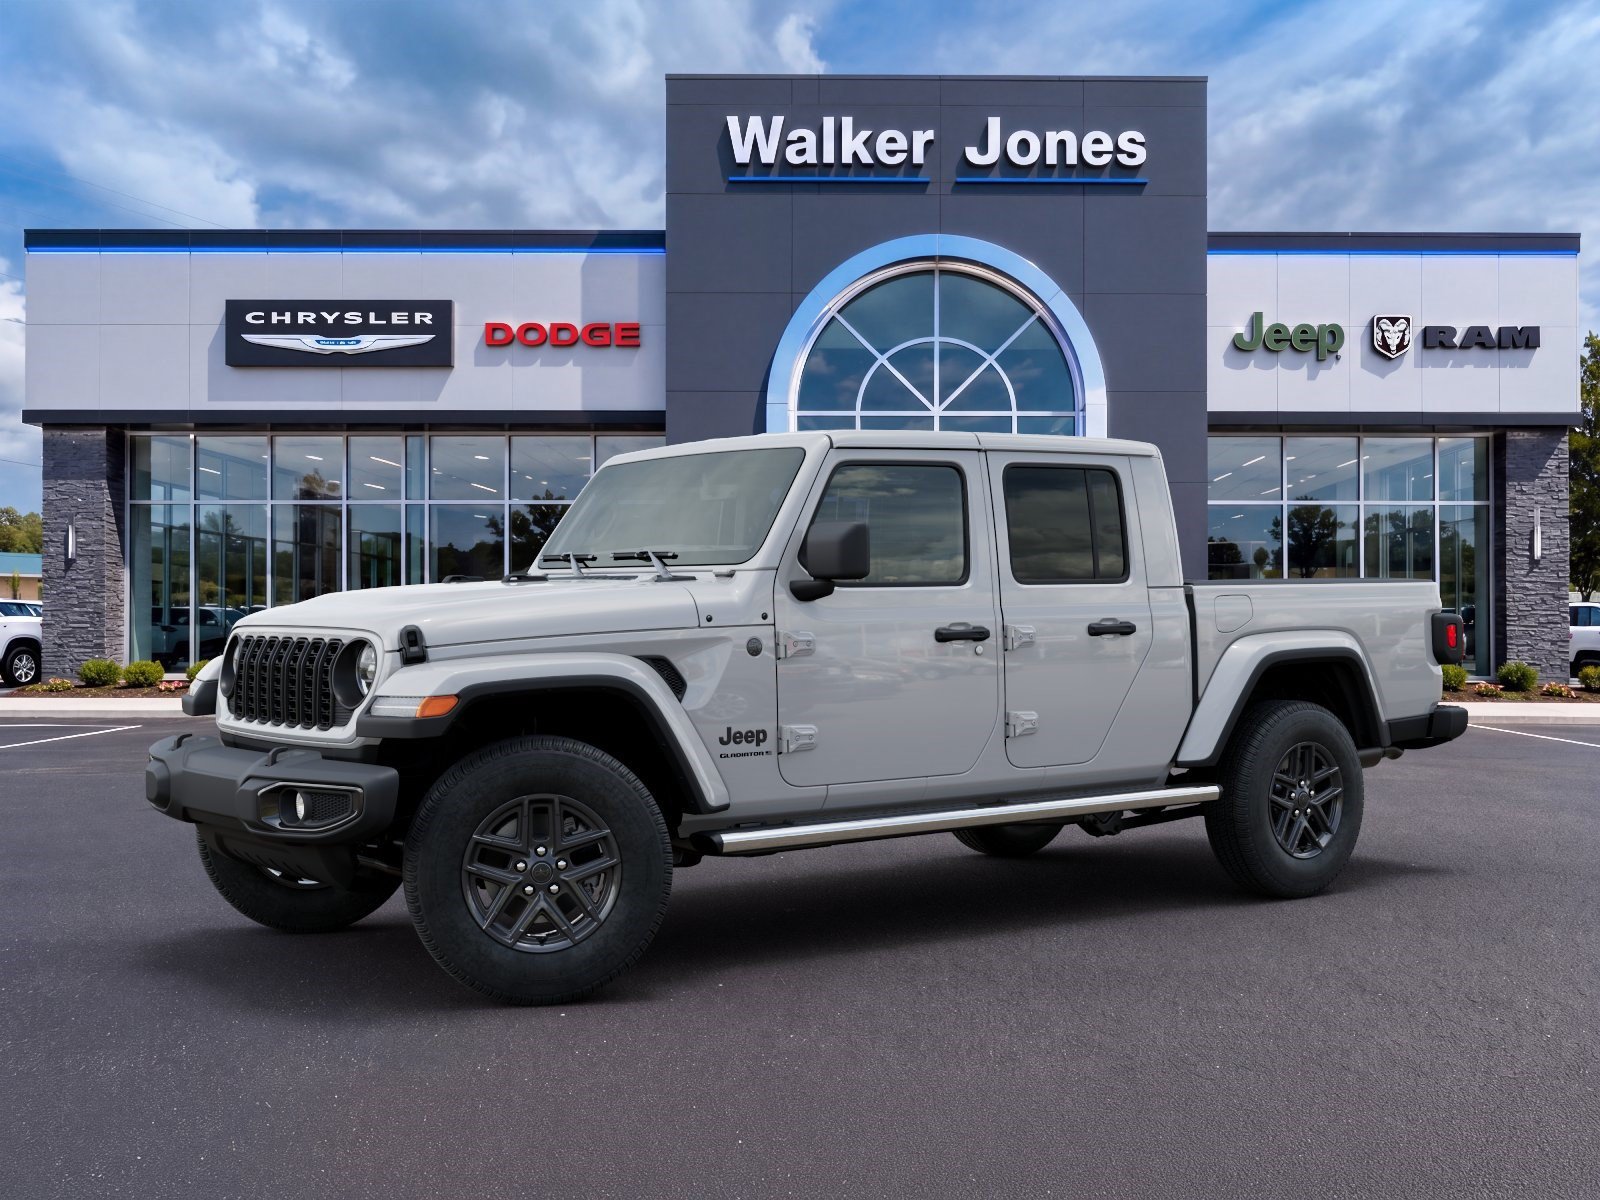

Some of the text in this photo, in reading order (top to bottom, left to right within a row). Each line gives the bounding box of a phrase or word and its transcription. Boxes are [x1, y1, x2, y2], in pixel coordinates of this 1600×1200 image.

[726, 115, 1147, 167] Walker Jones
[245, 311, 434, 326] CHRYSLER
[484, 322, 641, 348] DODGE
[1233, 311, 1345, 361] Jeep
[1423, 325, 1541, 348] RAM
[718, 726, 767, 747] Jeep
